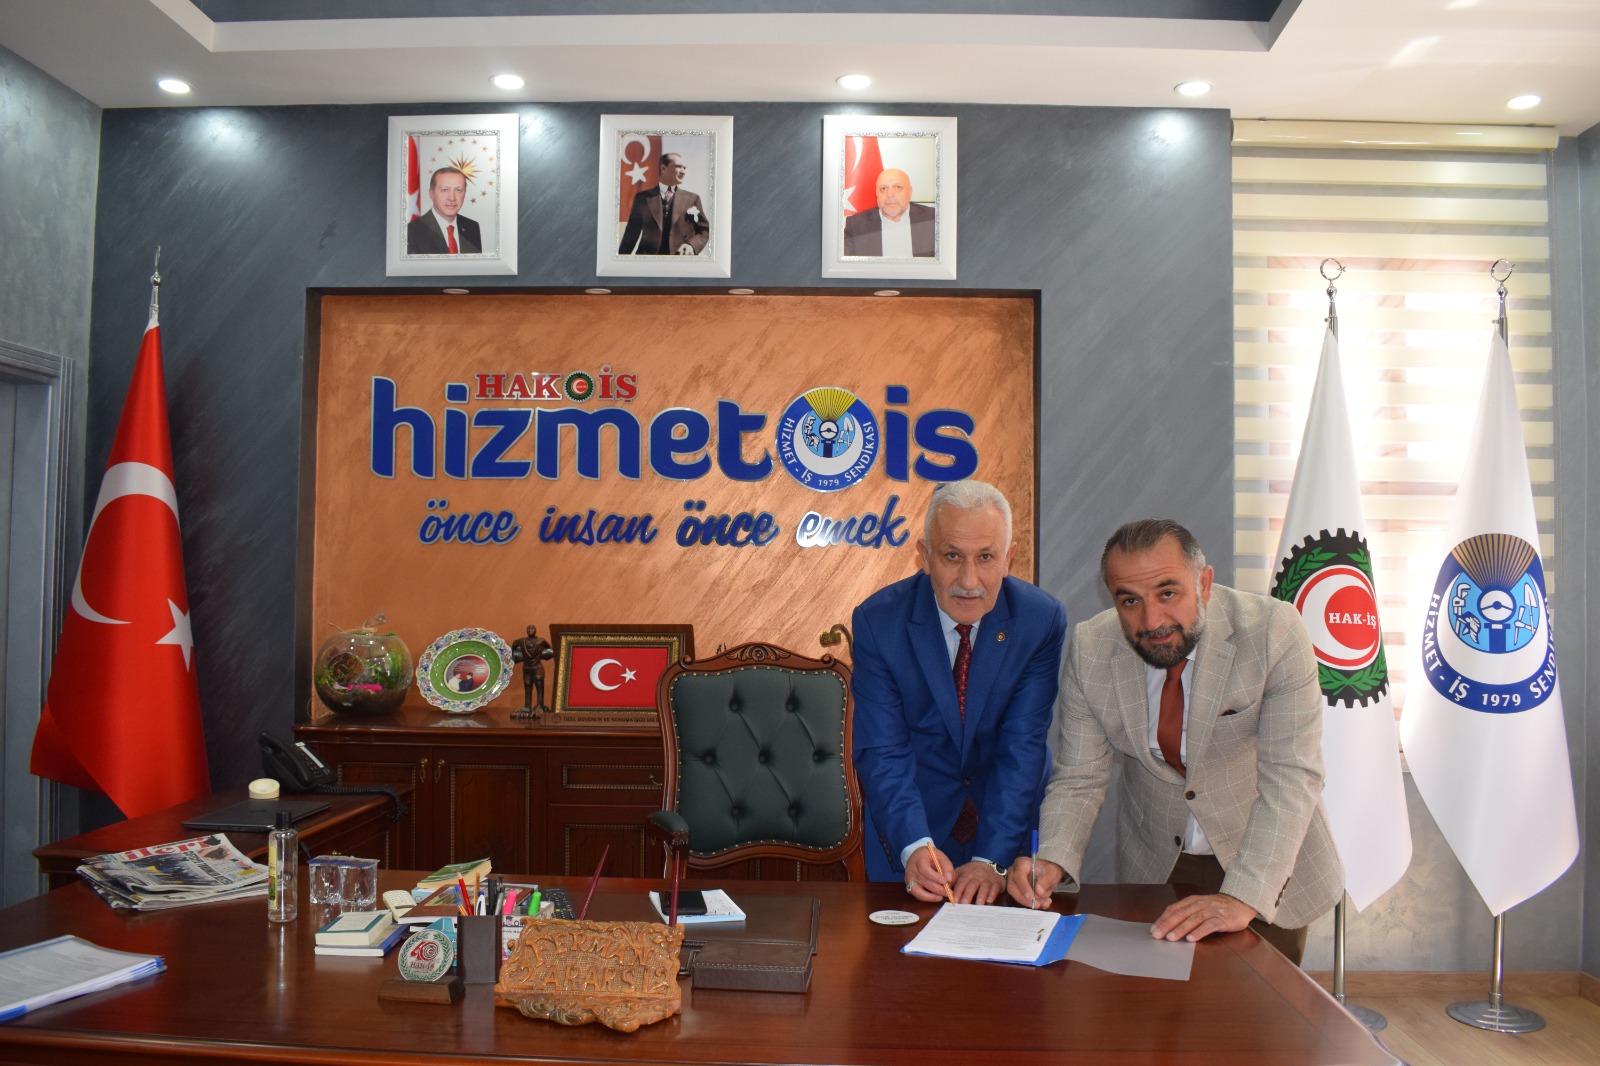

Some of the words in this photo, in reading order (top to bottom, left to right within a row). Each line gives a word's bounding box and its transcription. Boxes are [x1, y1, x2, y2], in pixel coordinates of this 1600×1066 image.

[475, 372, 562, 400] HAK
[598, 365, 638, 402] İŞ
[371, 376, 774, 482] hizmet
[844, 421, 875, 482] SENDİKASI
[818, 479, 840, 487] 1979
[419, 499, 521, 545] önce
[539, 506, 658, 547] insan
[676, 500, 780, 547] önce
[796, 494, 910, 549] emek
[1328, 612, 1377, 630] HAK-İŞ
[1424, 593, 1443, 672] HİZMET
[1482, 693, 1521, 707] 1979
